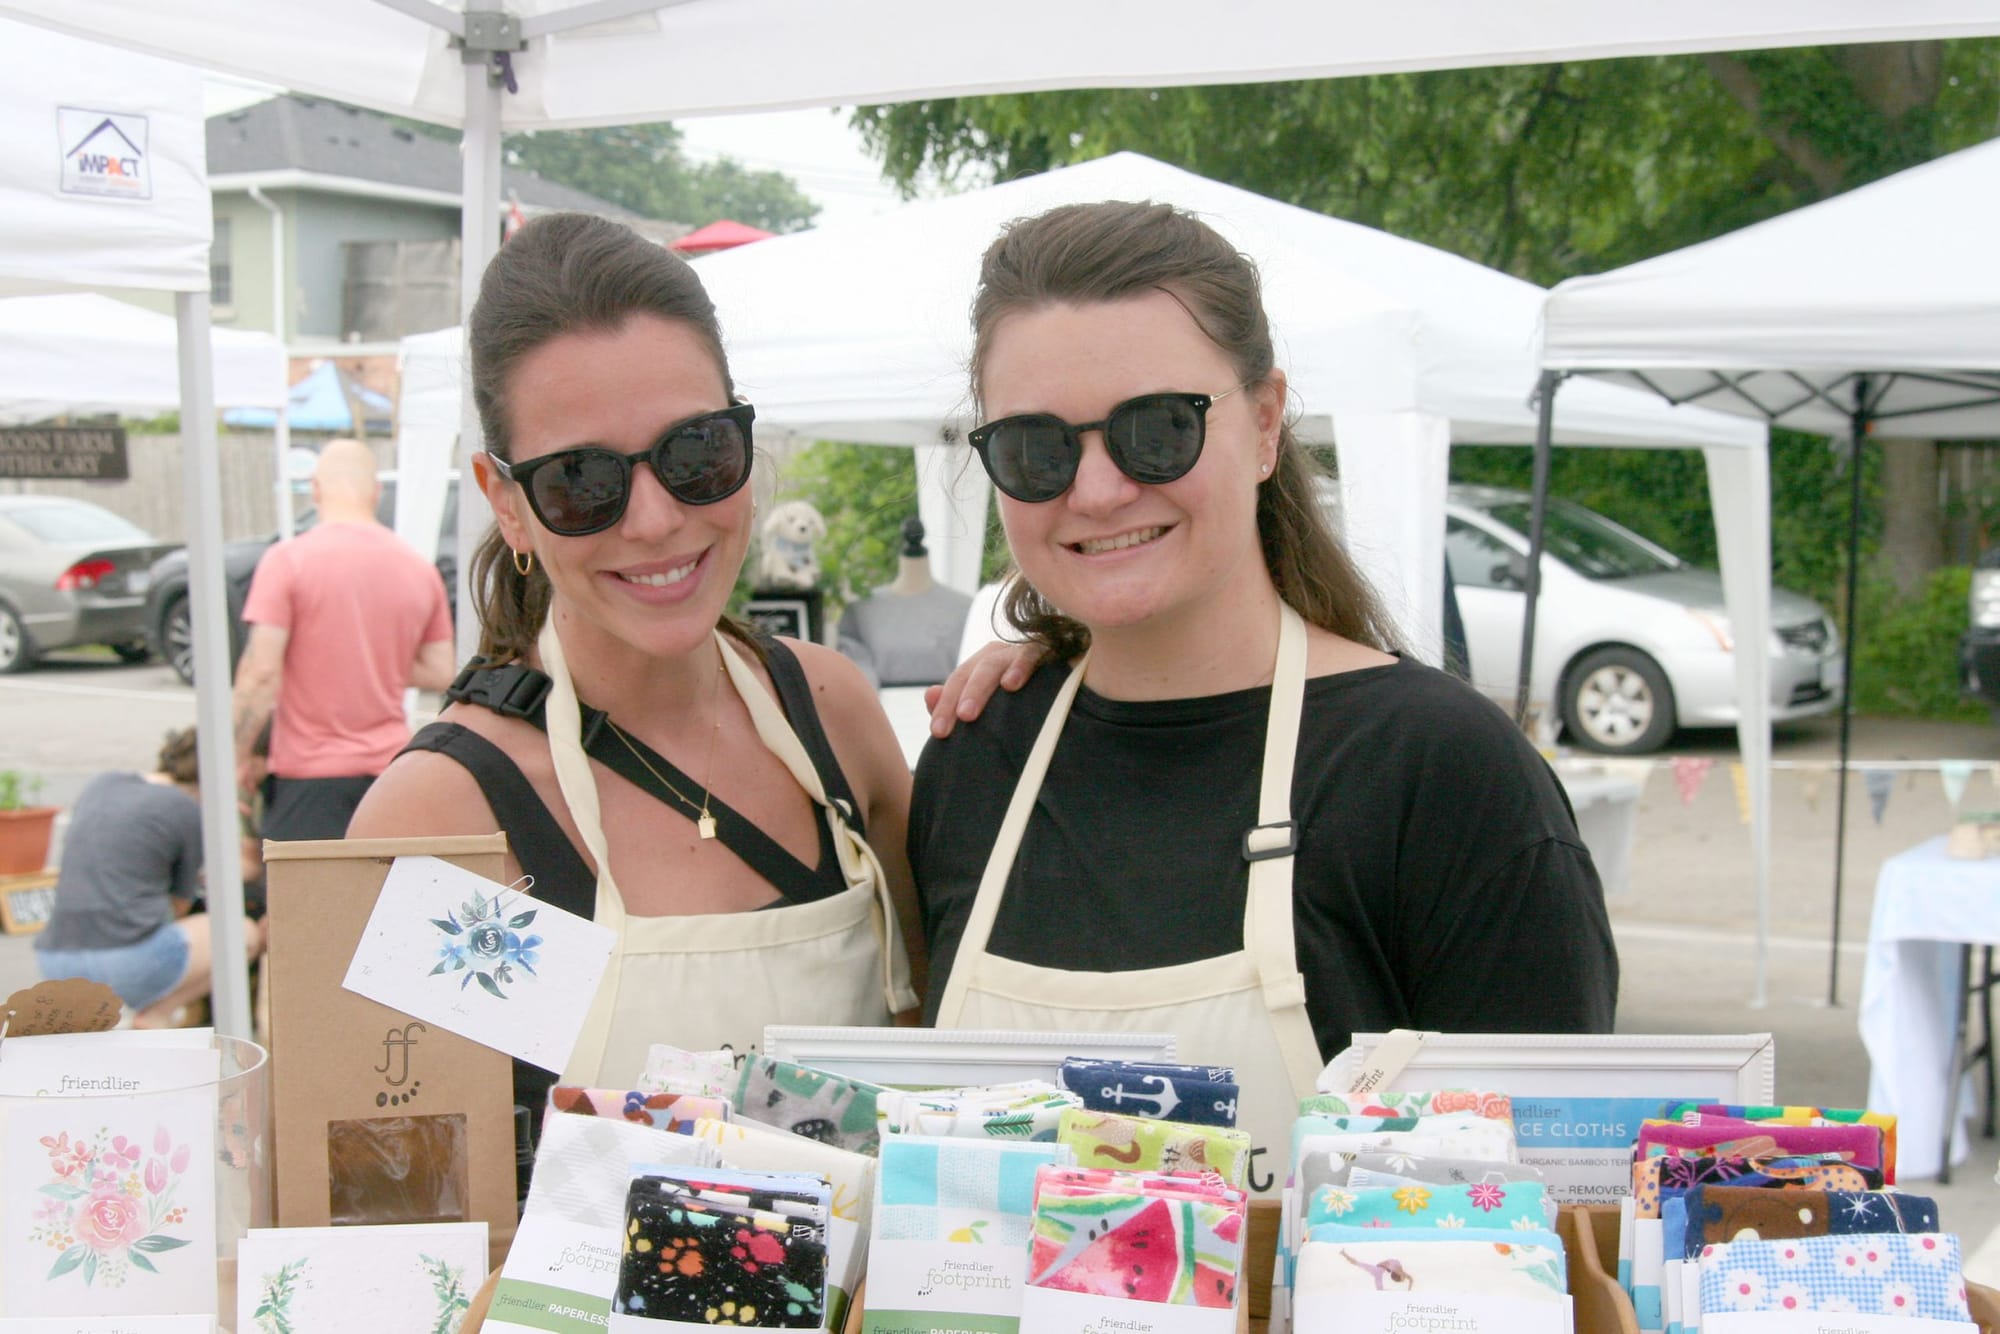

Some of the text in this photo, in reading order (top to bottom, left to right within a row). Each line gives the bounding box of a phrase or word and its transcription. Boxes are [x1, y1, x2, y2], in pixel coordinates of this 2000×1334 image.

[53, 431, 115, 454] FARM
[57, 1074, 141, 1094] friendlier
[1511, 1104, 1562, 1119] ndlier
[1550, 1122, 1627, 1137] CLOTHS
[1524, 1158, 1567, 1167] ORGANIC
[1568, 1158, 1609, 1167] BAMBOO
[577, 1241, 620, 1258] friendlie
[554, 1246, 619, 1274] footpri
[942, 1260, 993, 1272] friendlier
[922, 1268, 1011, 1290] footprint
[496, 1295, 546, 1311] friendlier
[1405, 1304, 1458, 1315] friendlier
[1097, 1316, 1154, 1333] friendlier
[1385, 1312, 1478, 1333] footprint
